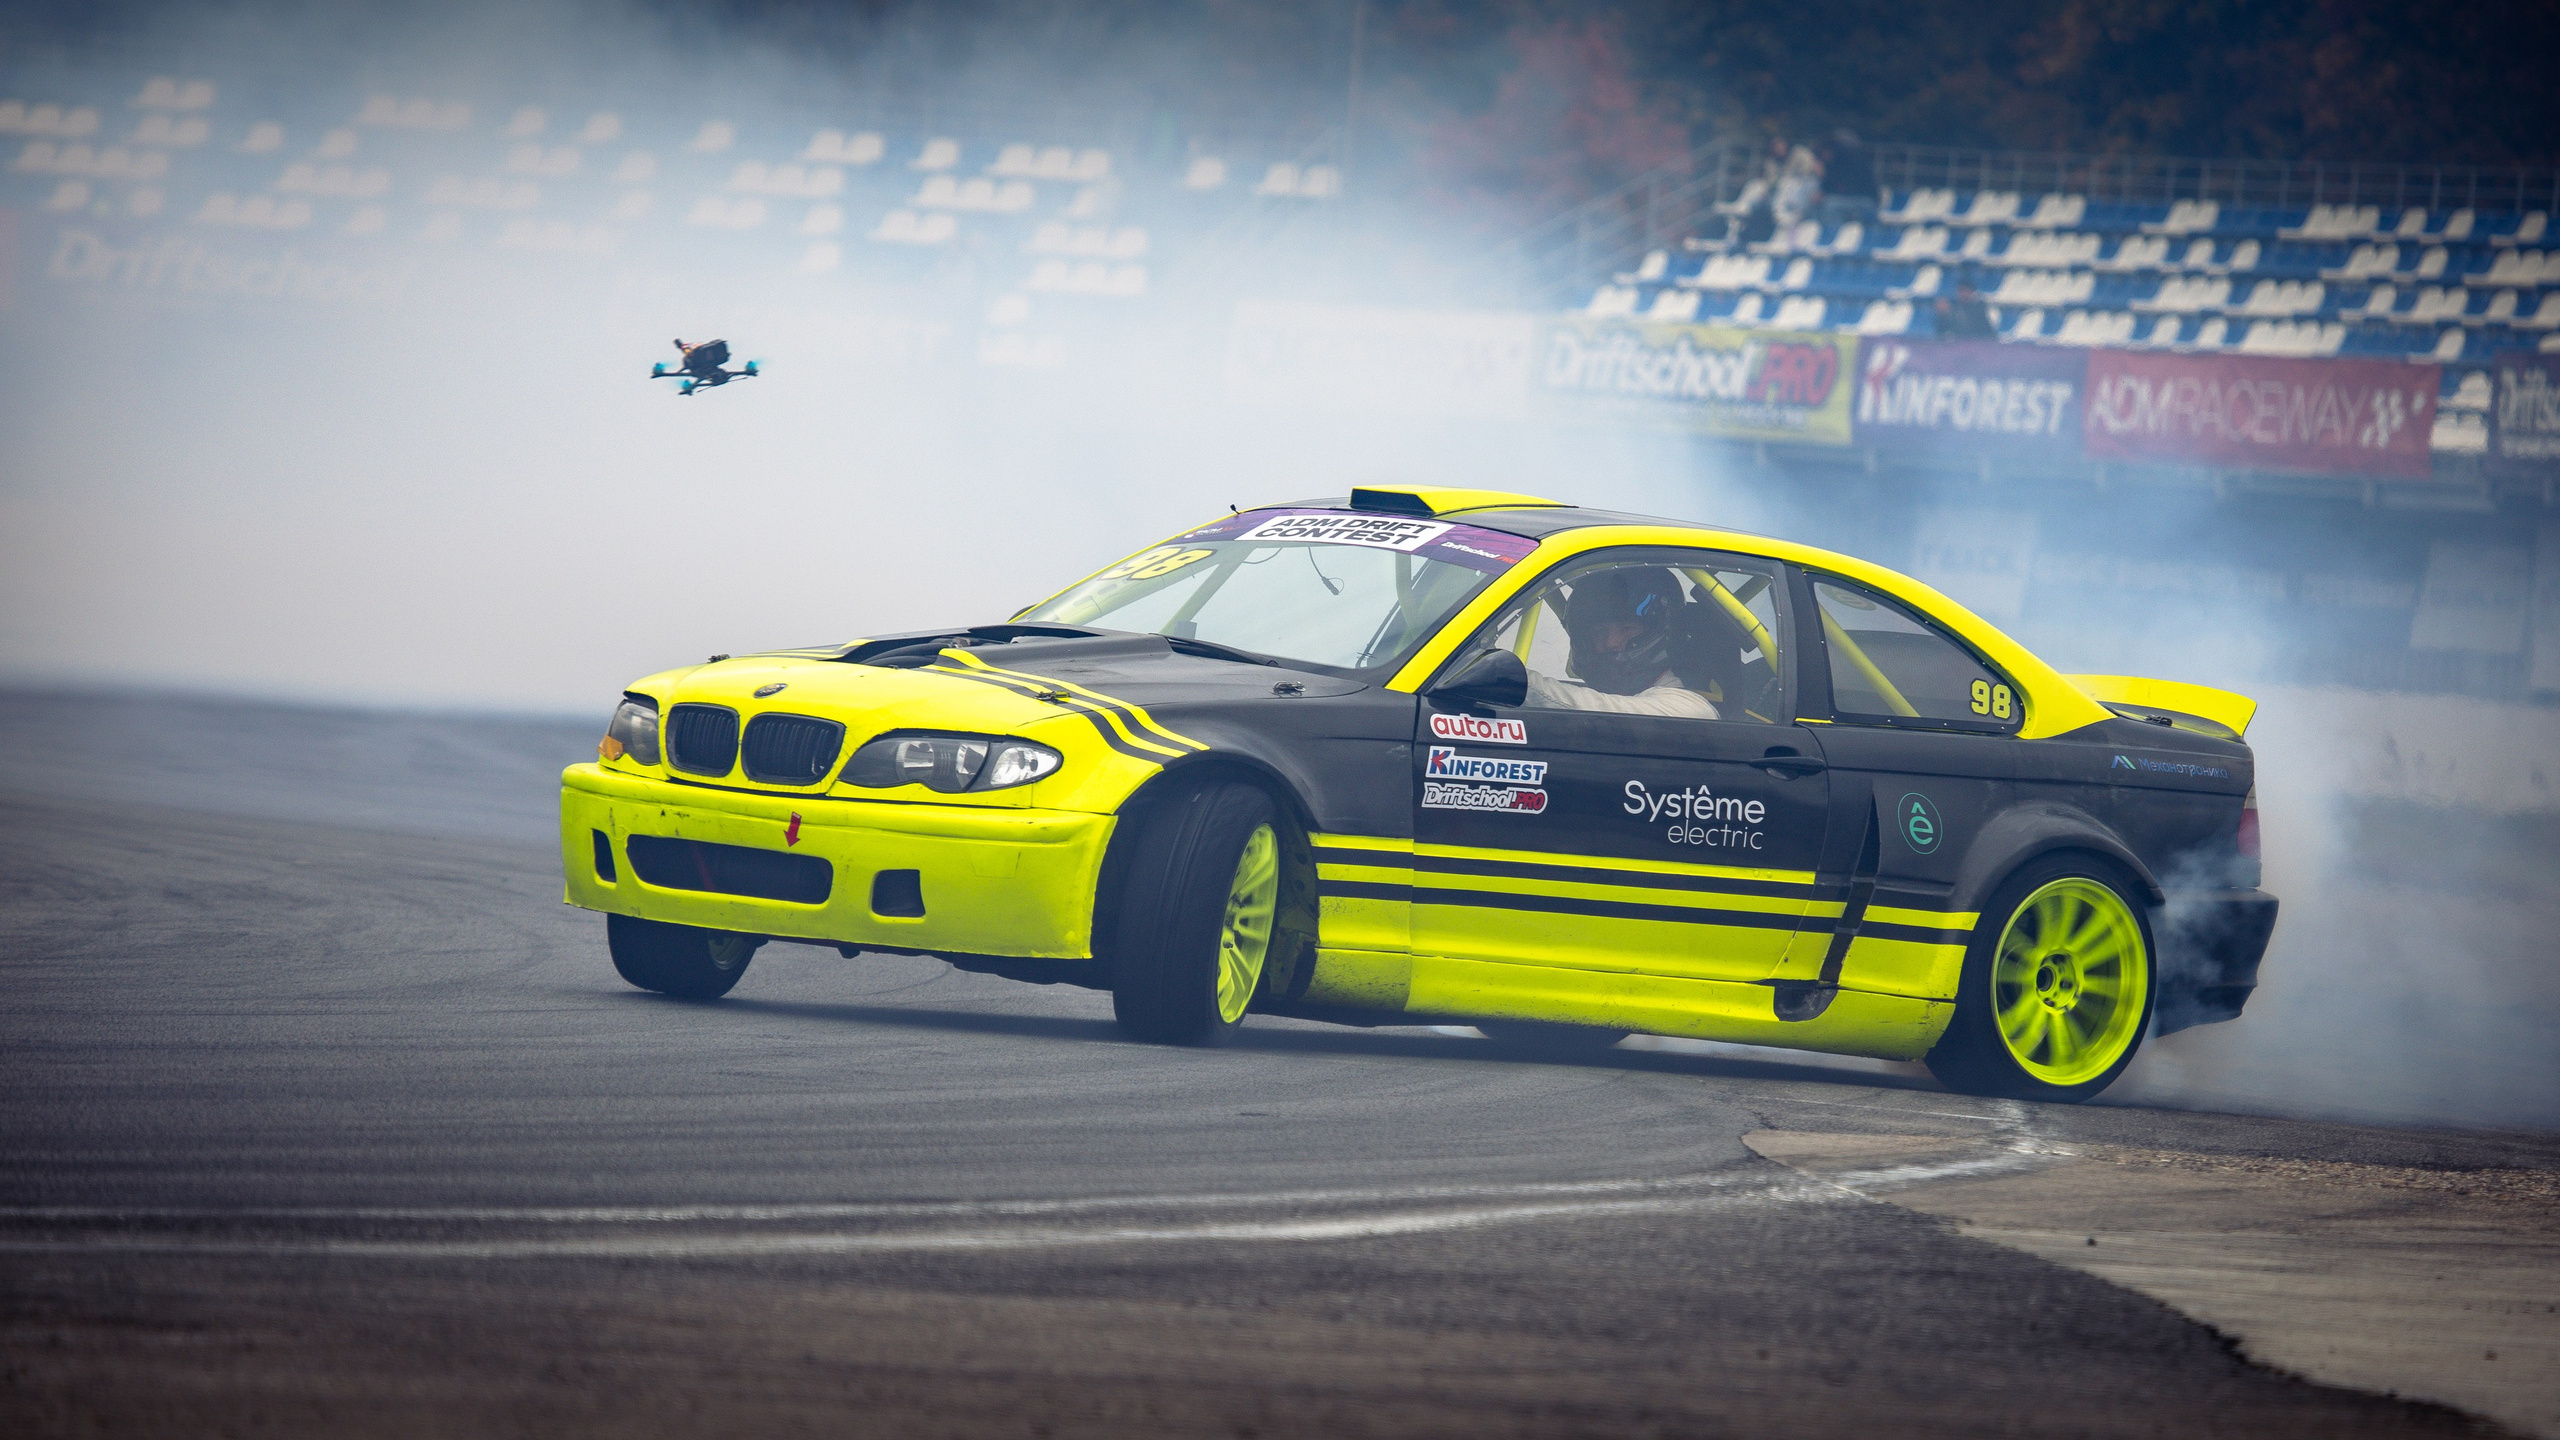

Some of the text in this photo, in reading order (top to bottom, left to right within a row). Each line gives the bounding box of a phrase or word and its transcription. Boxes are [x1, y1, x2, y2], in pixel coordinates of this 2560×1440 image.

[1858, 346, 2073, 434] KINFOREST
[1255, 528, 1419, 545] CONTEST
[1272, 518, 1436, 534] ADM DRIFT
[1098, 547, 1217, 580] 98
[1970, 679, 2011, 719] 98
[1433, 717, 1524, 741] auto.ru
[1429, 750, 1545, 781] KINFOREST
[2138, 758, 2229, 778] Механотроника
[1623, 780, 1766, 823] Systême
[1667, 819, 1764, 850] electric
